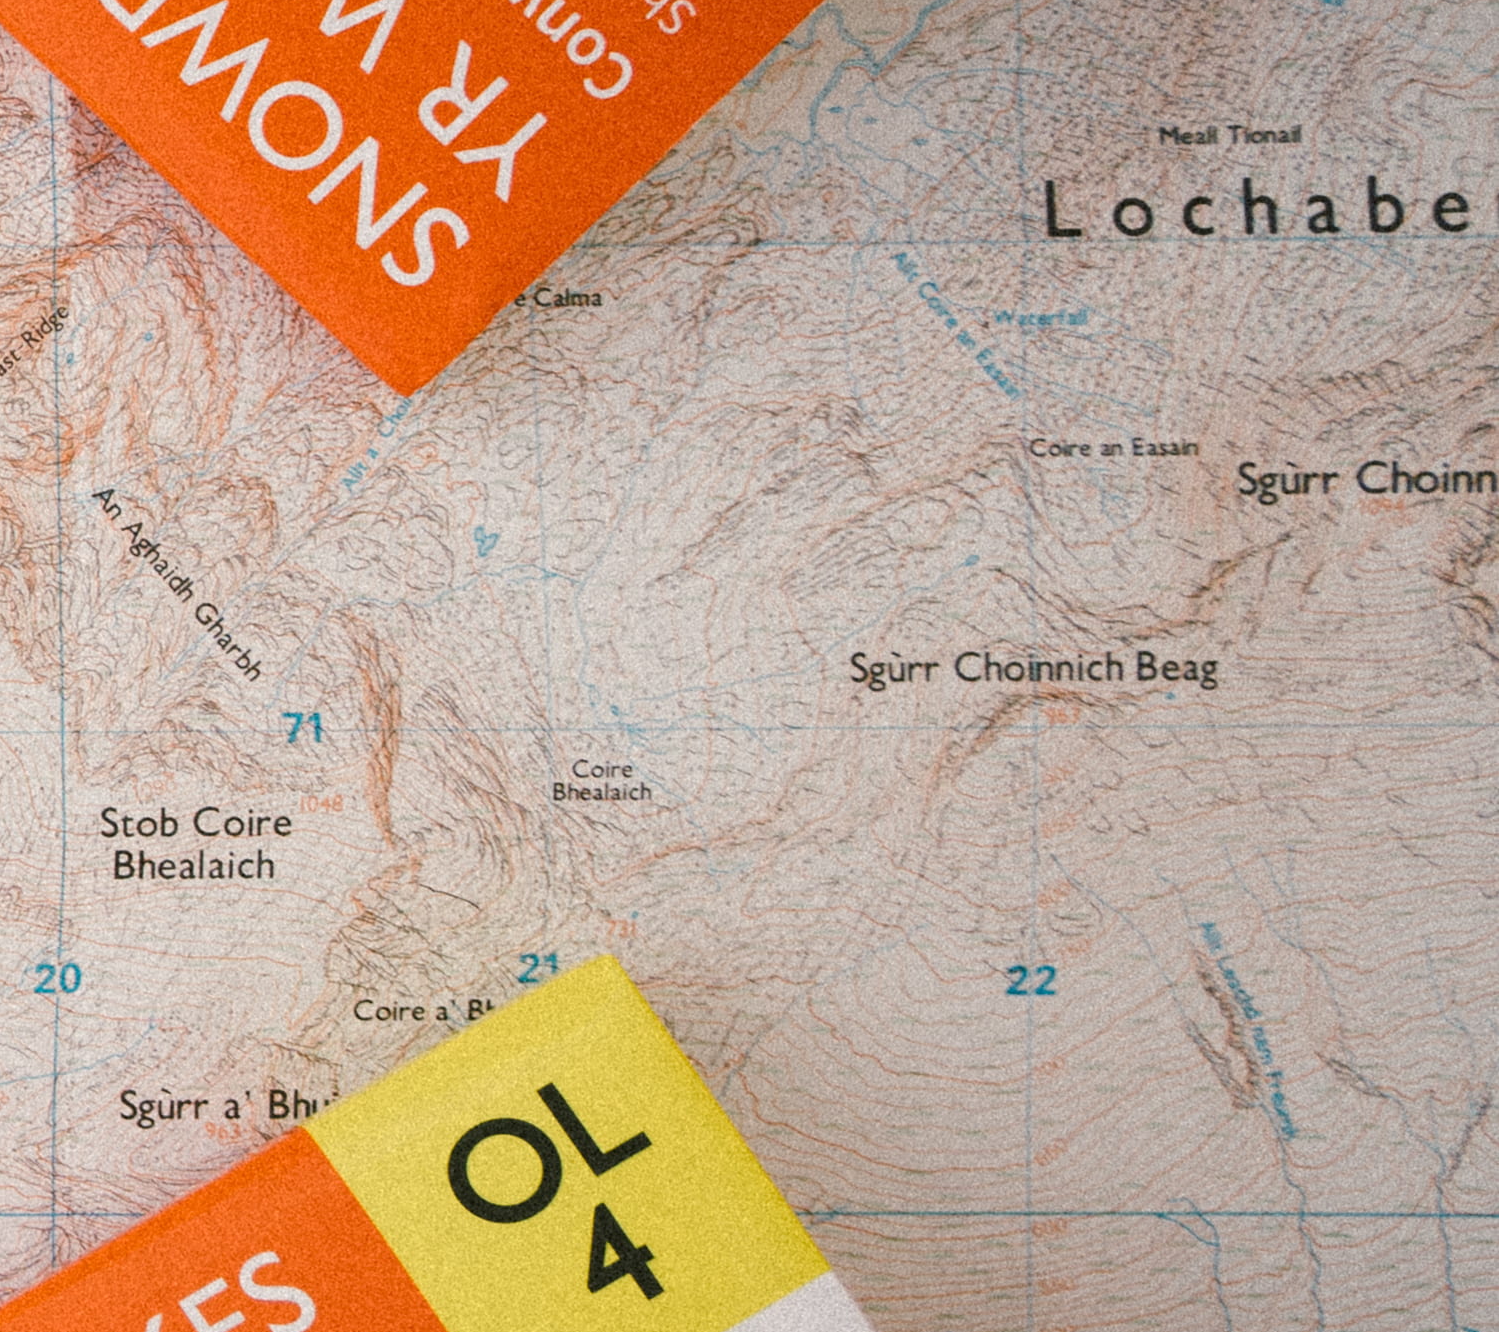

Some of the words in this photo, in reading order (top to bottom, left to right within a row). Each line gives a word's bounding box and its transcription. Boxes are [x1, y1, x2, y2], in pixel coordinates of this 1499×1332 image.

[418, 39, 549, 205] YR
[1043, 175, 1499, 239] Lochabe
[19, 301, 72, 364] Ridge
[847, 651, 940, 692] Sgùrr
[954, 651, 1126, 686] Choinnich
[1135, 653, 1219, 692] Beag
[100, 806, 180, 839] Stob
[193, 806, 293, 839] Coire
[111, 850, 277, 883] Bhealaich
[33, 962, 83, 997] 20
[1004, 964, 1058, 998] 22
[446, 1081, 654, 1226] OL
[586, 1201, 666, 1303] 4
